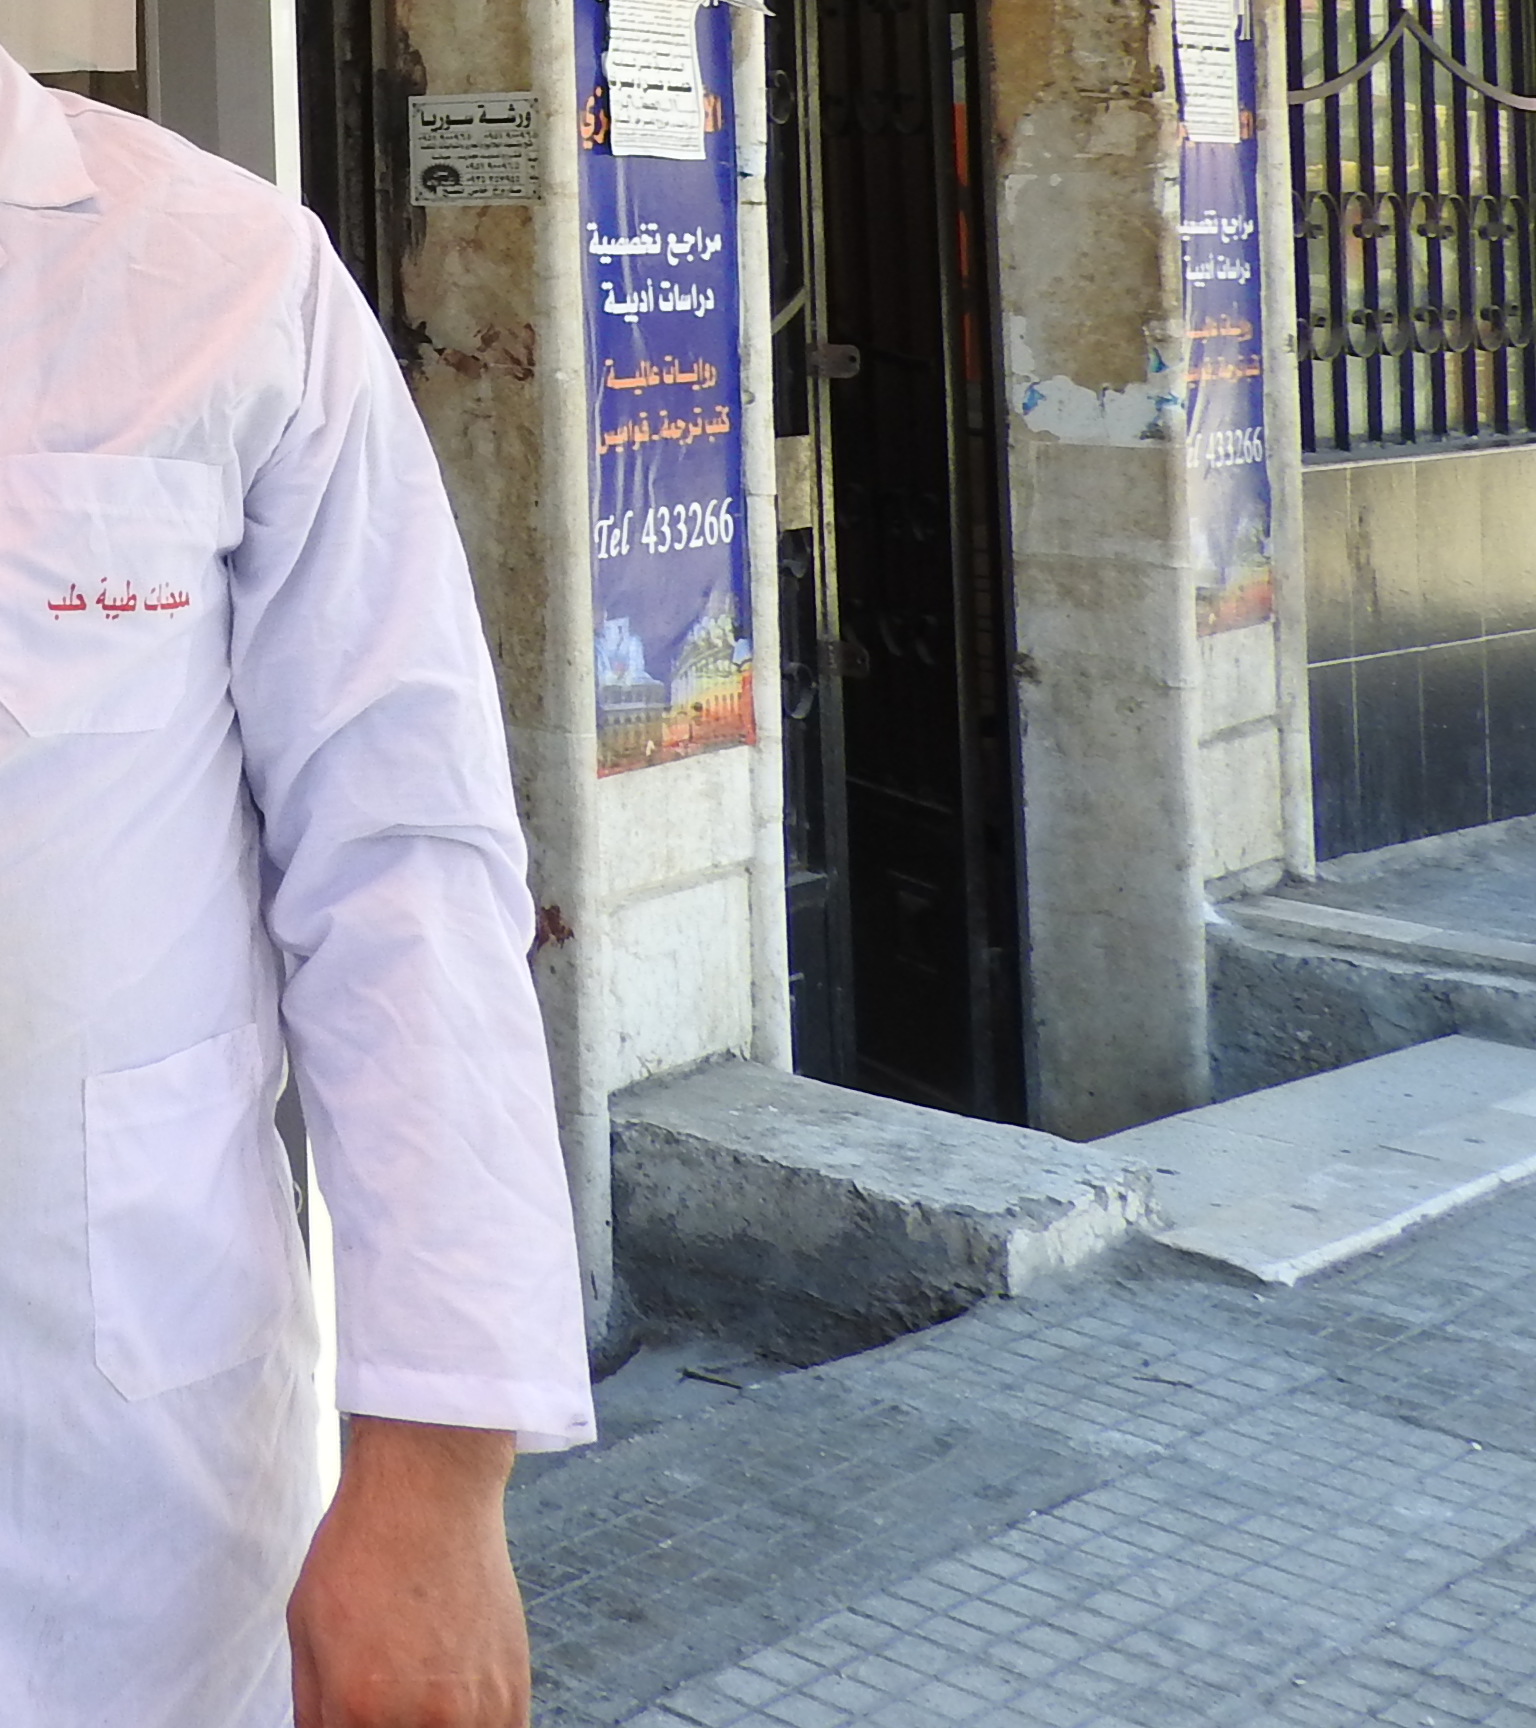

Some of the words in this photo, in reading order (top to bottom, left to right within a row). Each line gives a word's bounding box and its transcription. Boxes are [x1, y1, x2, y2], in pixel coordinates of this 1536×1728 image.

[421, 111, 473, 132] سوريا
[478, 104, 531, 128] ورشة
[586, 222, 661, 264] تخصصية
[667, 226, 722, 266] مراجع
[601, 278, 654, 323] أدبية
[658, 280, 715, 318] دراسات
[663, 355, 718, 391] روايات
[705, 405, 730, 443] كتب
[1206, 426, 1263, 468] 433266
[594, 510, 634, 559] Tel
[641, 497, 734, 554] 433266
[47, 583, 87, 620] حلب
[95, 577, 137, 620] طيبة
